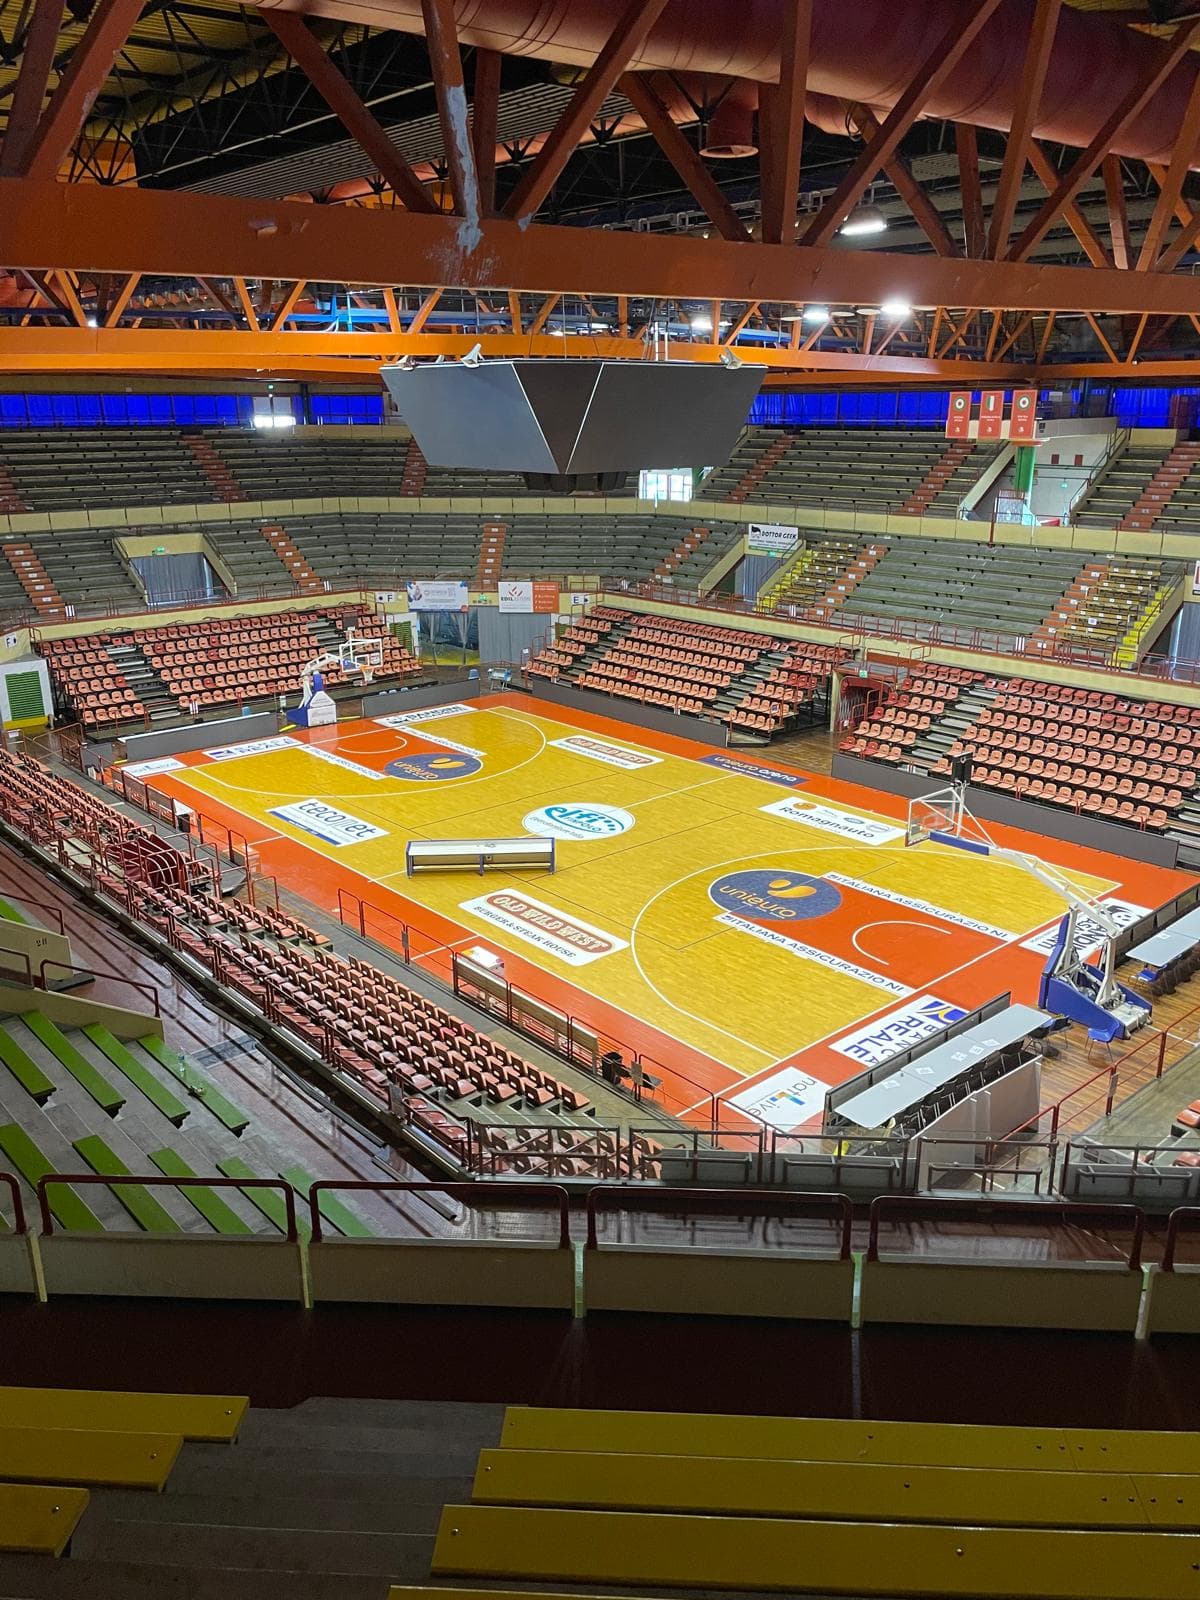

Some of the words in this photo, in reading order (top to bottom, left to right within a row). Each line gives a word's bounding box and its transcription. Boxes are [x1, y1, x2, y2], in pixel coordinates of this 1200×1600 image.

[779, 806, 874, 838] Romagnauto
[720, 885, 797, 917] unieuro
[493, 896, 527, 913] OLD
[521, 908, 564, 930] WILD
[557, 925, 609, 951] WEST
[544, 940, 577, 958] HOUSE
[843, 1015, 924, 1059] REALE
